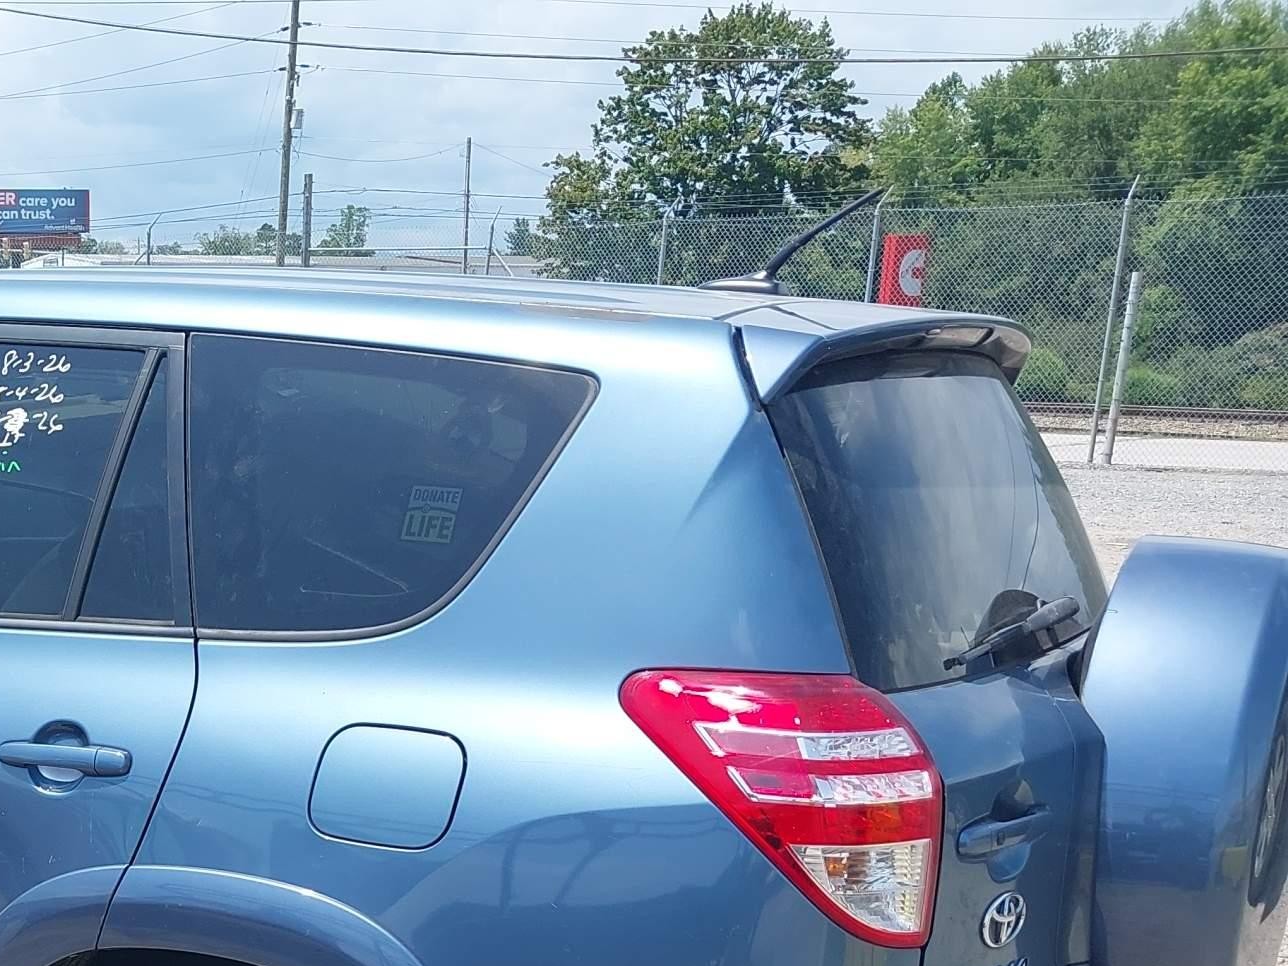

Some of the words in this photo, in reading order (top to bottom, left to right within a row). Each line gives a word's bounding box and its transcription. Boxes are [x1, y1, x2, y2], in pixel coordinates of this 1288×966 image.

[19, 197, 47, 207] care
[51, 197, 75, 209] you
[20, 208, 55, 219] trust.
[413, 488, 459, 505] DONATE
[405, 513, 453, 540] LIFE
